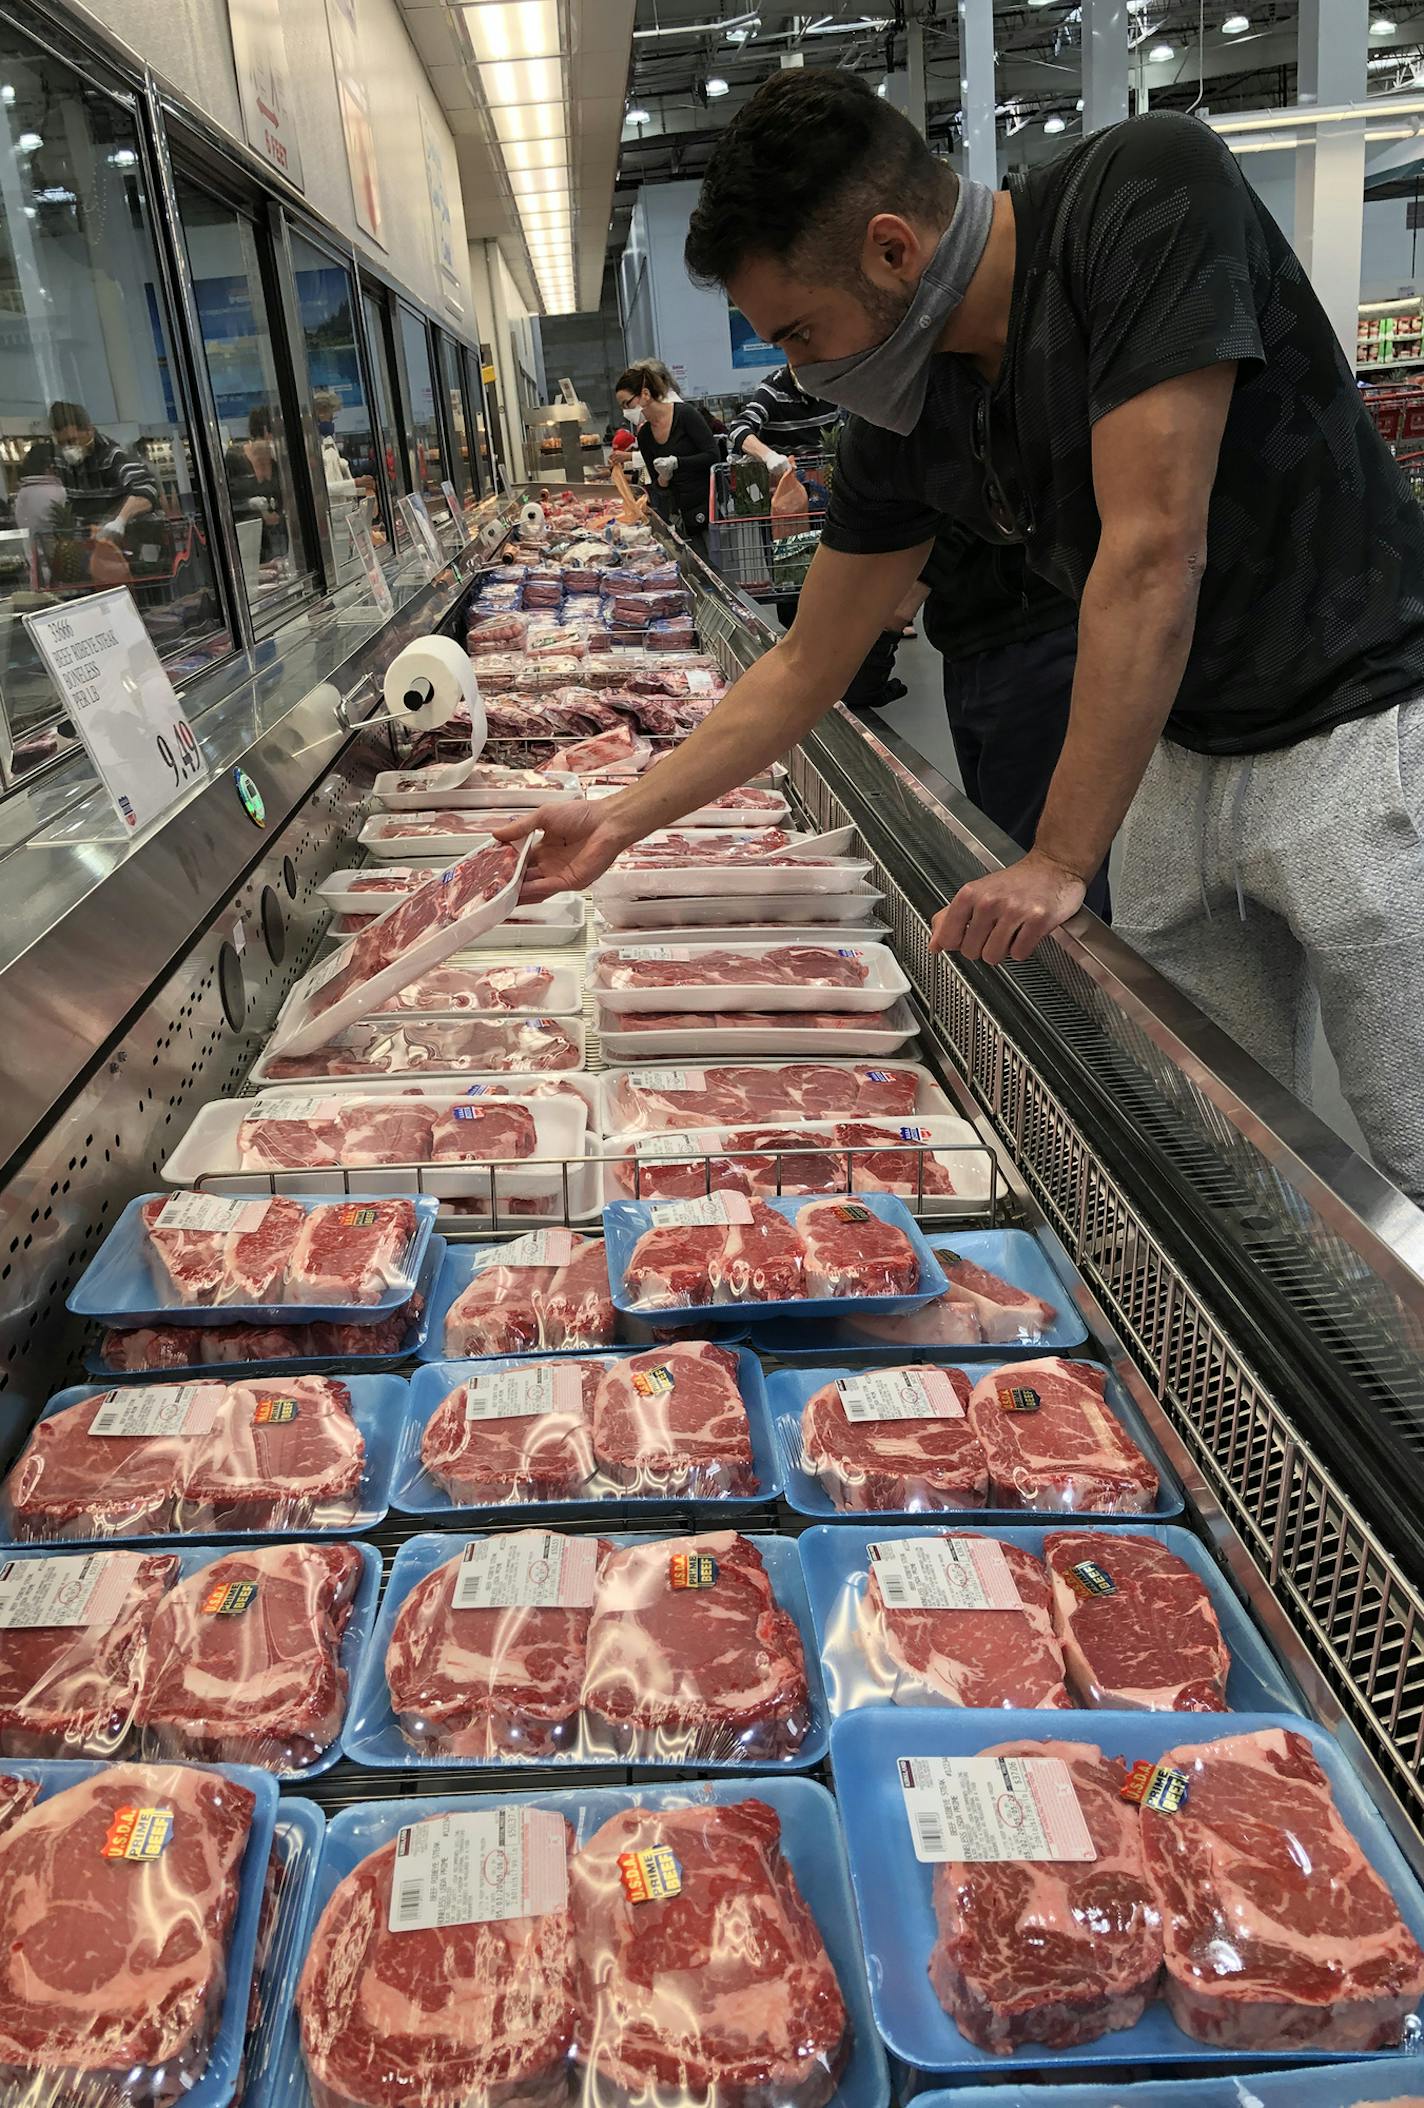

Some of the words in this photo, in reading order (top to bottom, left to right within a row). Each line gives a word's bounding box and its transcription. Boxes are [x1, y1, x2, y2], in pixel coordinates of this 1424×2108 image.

[271, 136, 288, 170] FEET
[52, 646, 73, 668] BEEF
[71, 637, 99, 661] RIBEYE
[95, 630, 119, 651] STEAK
[63, 661, 101, 689] BONELESS
[72, 691, 90, 710] PER
[88, 686, 100, 703] LB
[157, 720, 200, 787] 9.49
[701, 1558, 712, 1581] BEEF
[1083, 1567, 1110, 1589] BEEF
[221, 1584, 240, 1610] PRIME
[233, 1585, 253, 1608] BEEF
[1008, 1761, 1021, 1783] $37.06
[937, 1778, 948, 1795] STEAK
[1147, 1768, 1169, 1806] PRIME
[1162, 1778, 1185, 1811] BEEF
[942, 1799, 954, 1818] RIBEYE
[950, 1795, 961, 1812] PRIME
[129, 1814, 151, 1857] PRIME
[145, 1817, 168, 1854] BEEF
[947, 1821, 958, 1835] BEEF
[644, 1855, 661, 1897] PRIME
[658, 1855, 679, 1889] BEEF
[429, 1885, 437, 1901] BEEF
